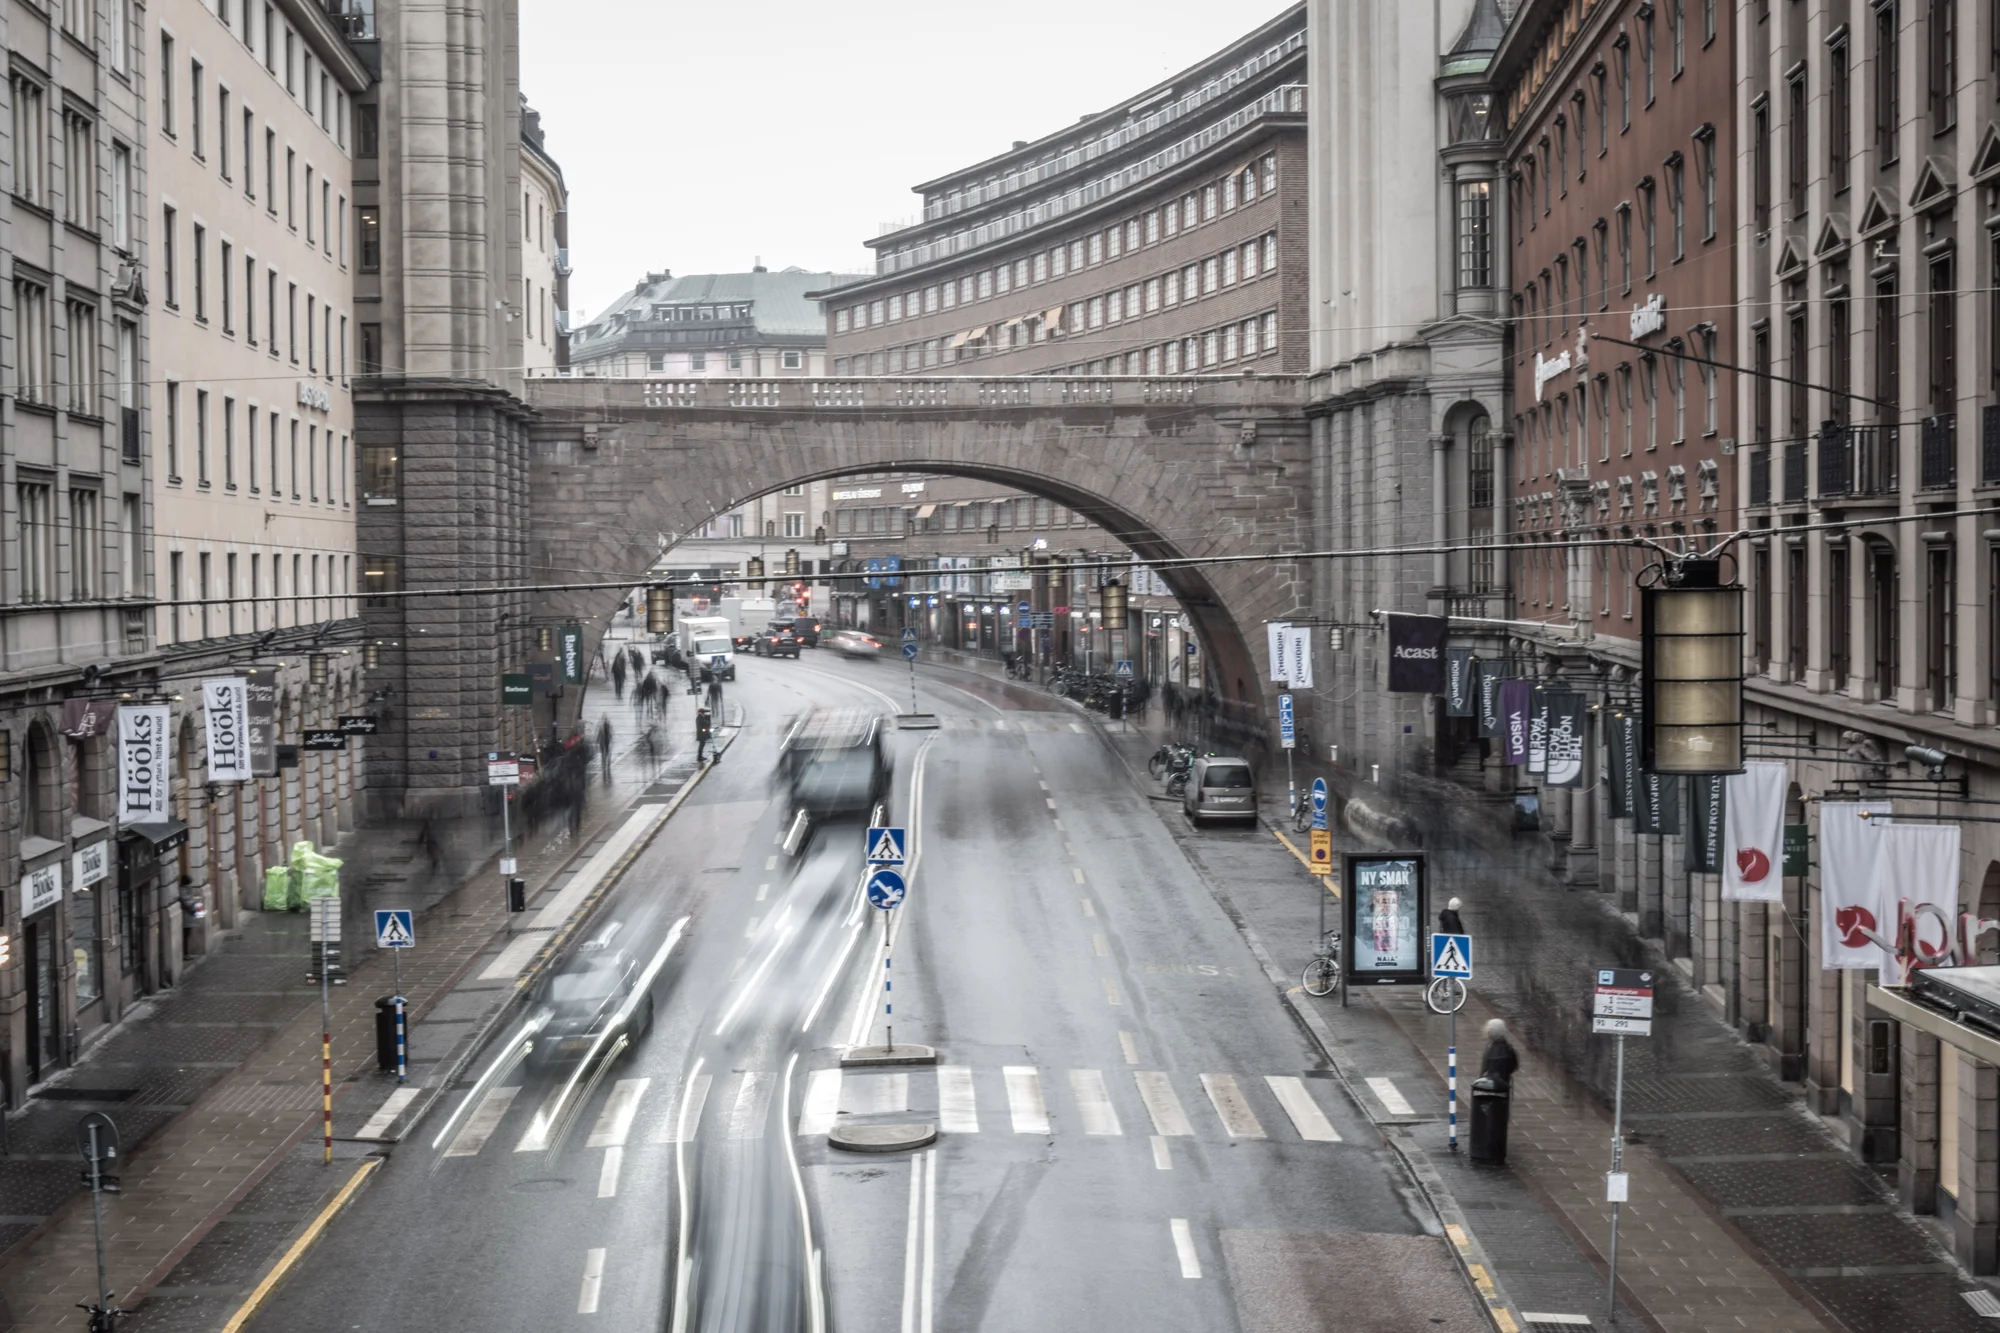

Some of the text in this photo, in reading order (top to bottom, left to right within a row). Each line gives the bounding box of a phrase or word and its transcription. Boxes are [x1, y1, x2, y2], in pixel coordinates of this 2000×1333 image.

[564, 634, 577, 678] Barbour
[1276, 631, 1285, 668] HOUDINI
[1294, 637, 1303, 675] HOUDINI
[1393, 645, 1438, 659] Acast
[1282, 697, 1290, 709] P
[155, 716, 163, 735] hund
[209, 686, 236, 772] Hööks
[247, 716, 271, 725] USHI
[1529, 718, 1541, 749] FACE
[1559, 715, 1573, 760] NORTH
[155, 743, 164, 760] häst
[1547, 727, 1560, 760] FACE
[1570, 735, 1583, 760] THE
[125, 714, 152, 814] Hööks
[155, 760, 164, 786] ryttare,
[1624, 727, 1633, 813] NATURKOMPANIET
[155, 788, 164, 798] för
[155, 799, 164, 812] Allt
[1361, 870, 1409, 886] NY SMAK
[1602, 1005, 1614, 1014] 75
[1609, 996, 1613, 1004] 1
[1596, 1019, 1605, 1027] 91
[1614, 1020, 1629, 1028] 291
